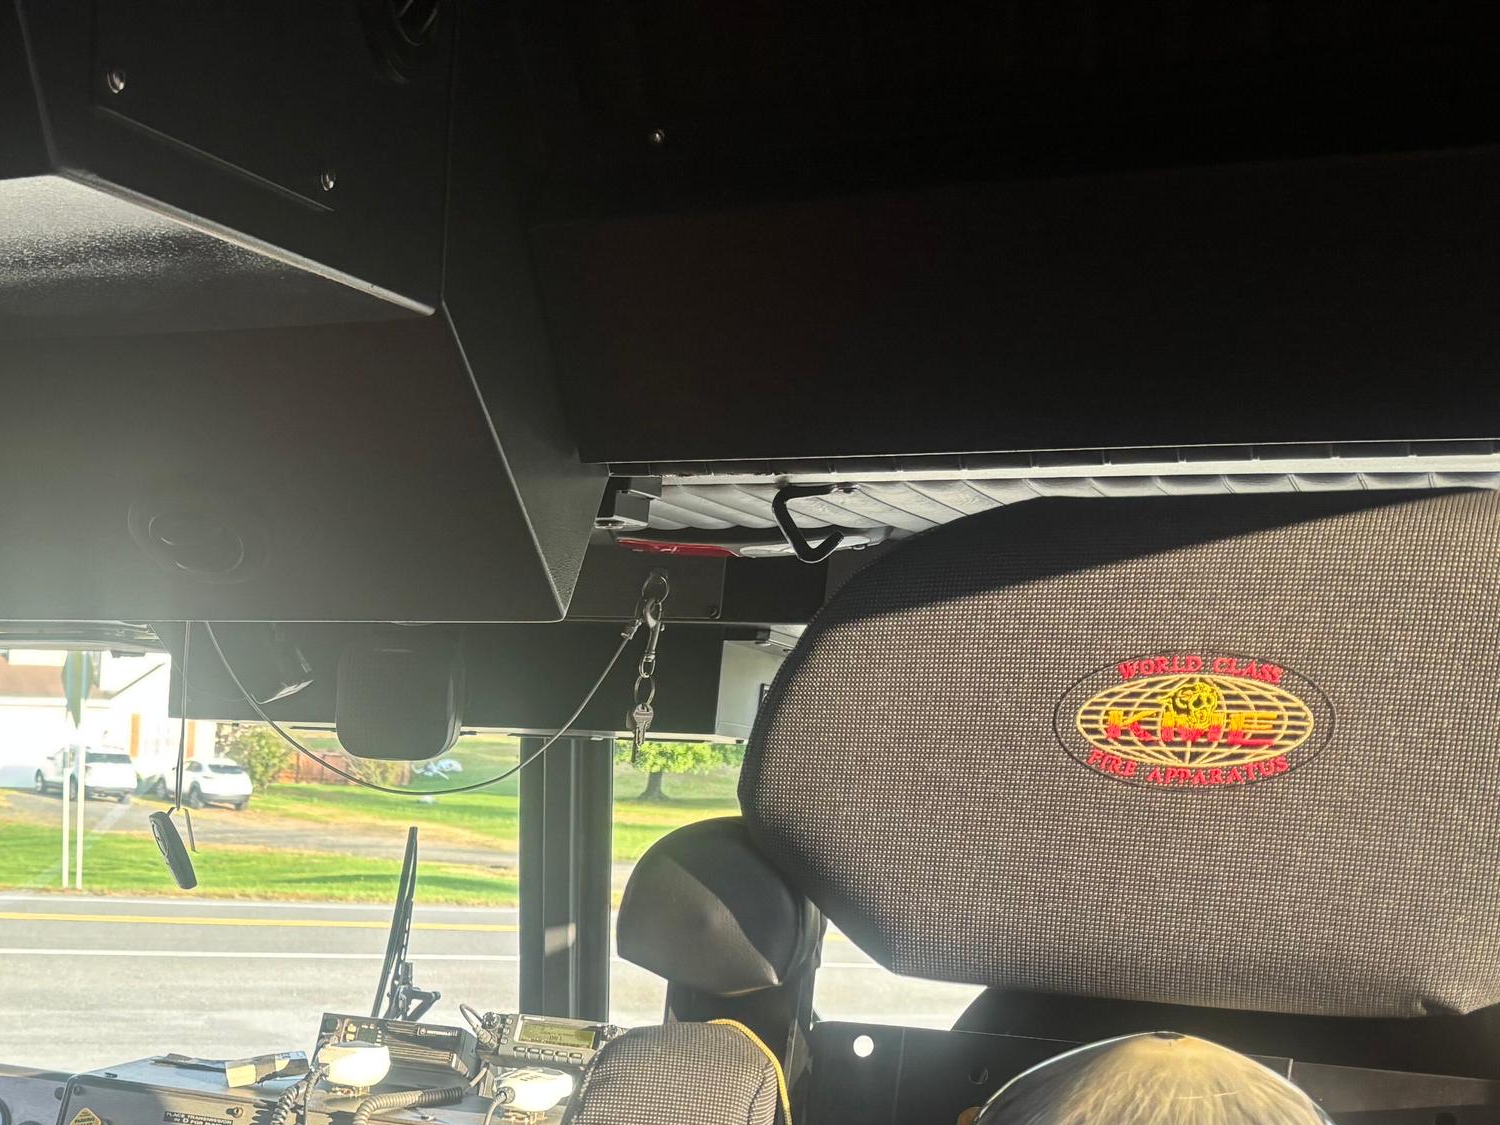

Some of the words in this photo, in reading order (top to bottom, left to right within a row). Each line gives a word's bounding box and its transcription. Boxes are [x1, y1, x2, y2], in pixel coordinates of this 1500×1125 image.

[1118, 655, 1204, 681] WORLD
[1213, 657, 1285, 684] CLASS
[1104, 709, 1278, 747] KME
[1087, 749, 1138, 778] FIRE
[1146, 755, 1290, 785] APPARATUS
